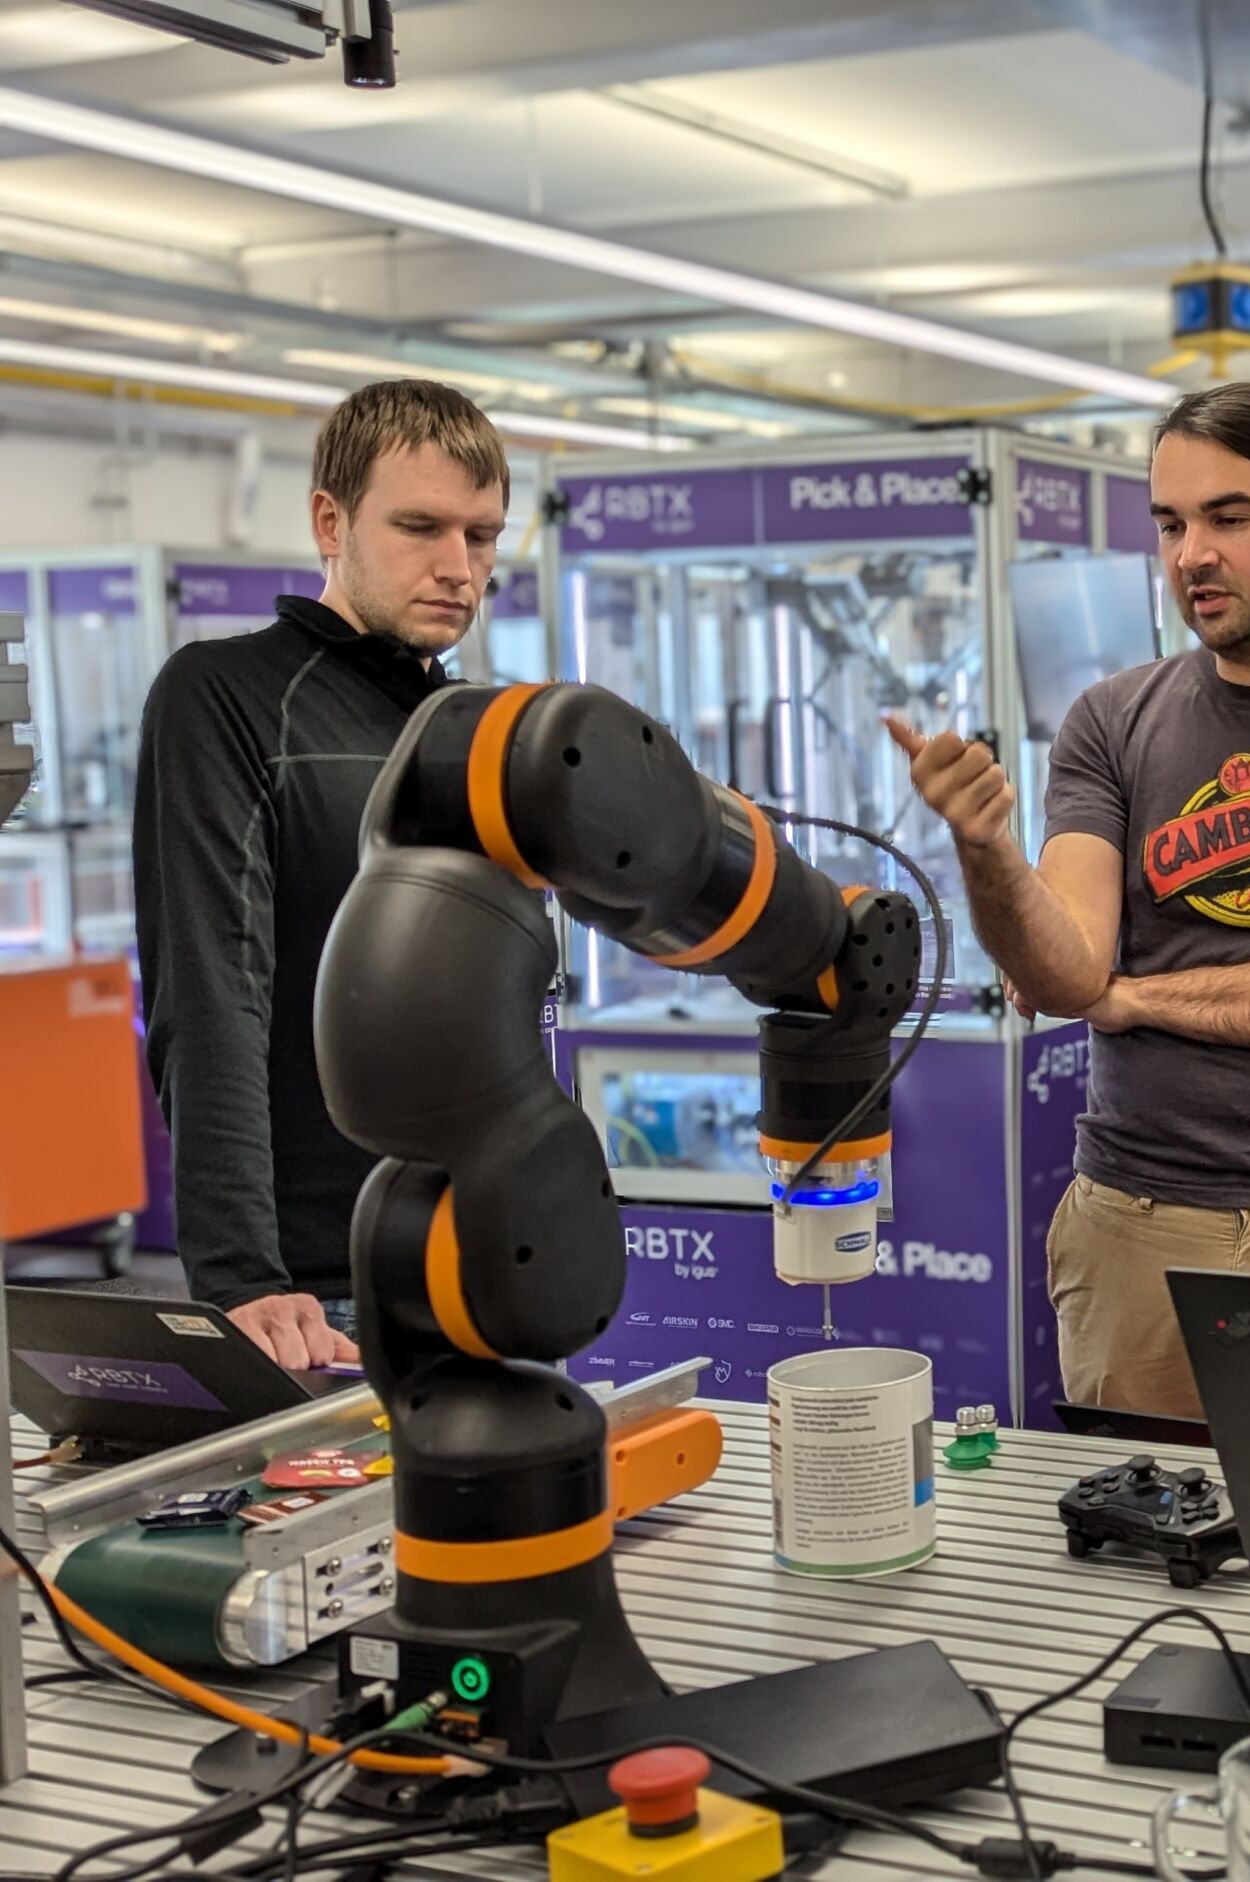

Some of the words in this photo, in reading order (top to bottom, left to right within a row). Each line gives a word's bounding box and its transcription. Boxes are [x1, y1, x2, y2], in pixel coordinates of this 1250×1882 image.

[604, 484, 694, 521] RBTX
[790, 475, 850, 511] Pick
[854, 473, 878, 508] &
[881, 471, 962, 506] Place
[1050, 1040, 1090, 1080] RBT
[624, 1226, 716, 1262] RBTX
[875, 1240, 899, 1276] &
[903, 1240, 993, 1283] Place
[674, 1262, 690, 1279] by
[662, 1316, 699, 1327] AIRSKIN
[89, 1366, 161, 1387] RBTX
